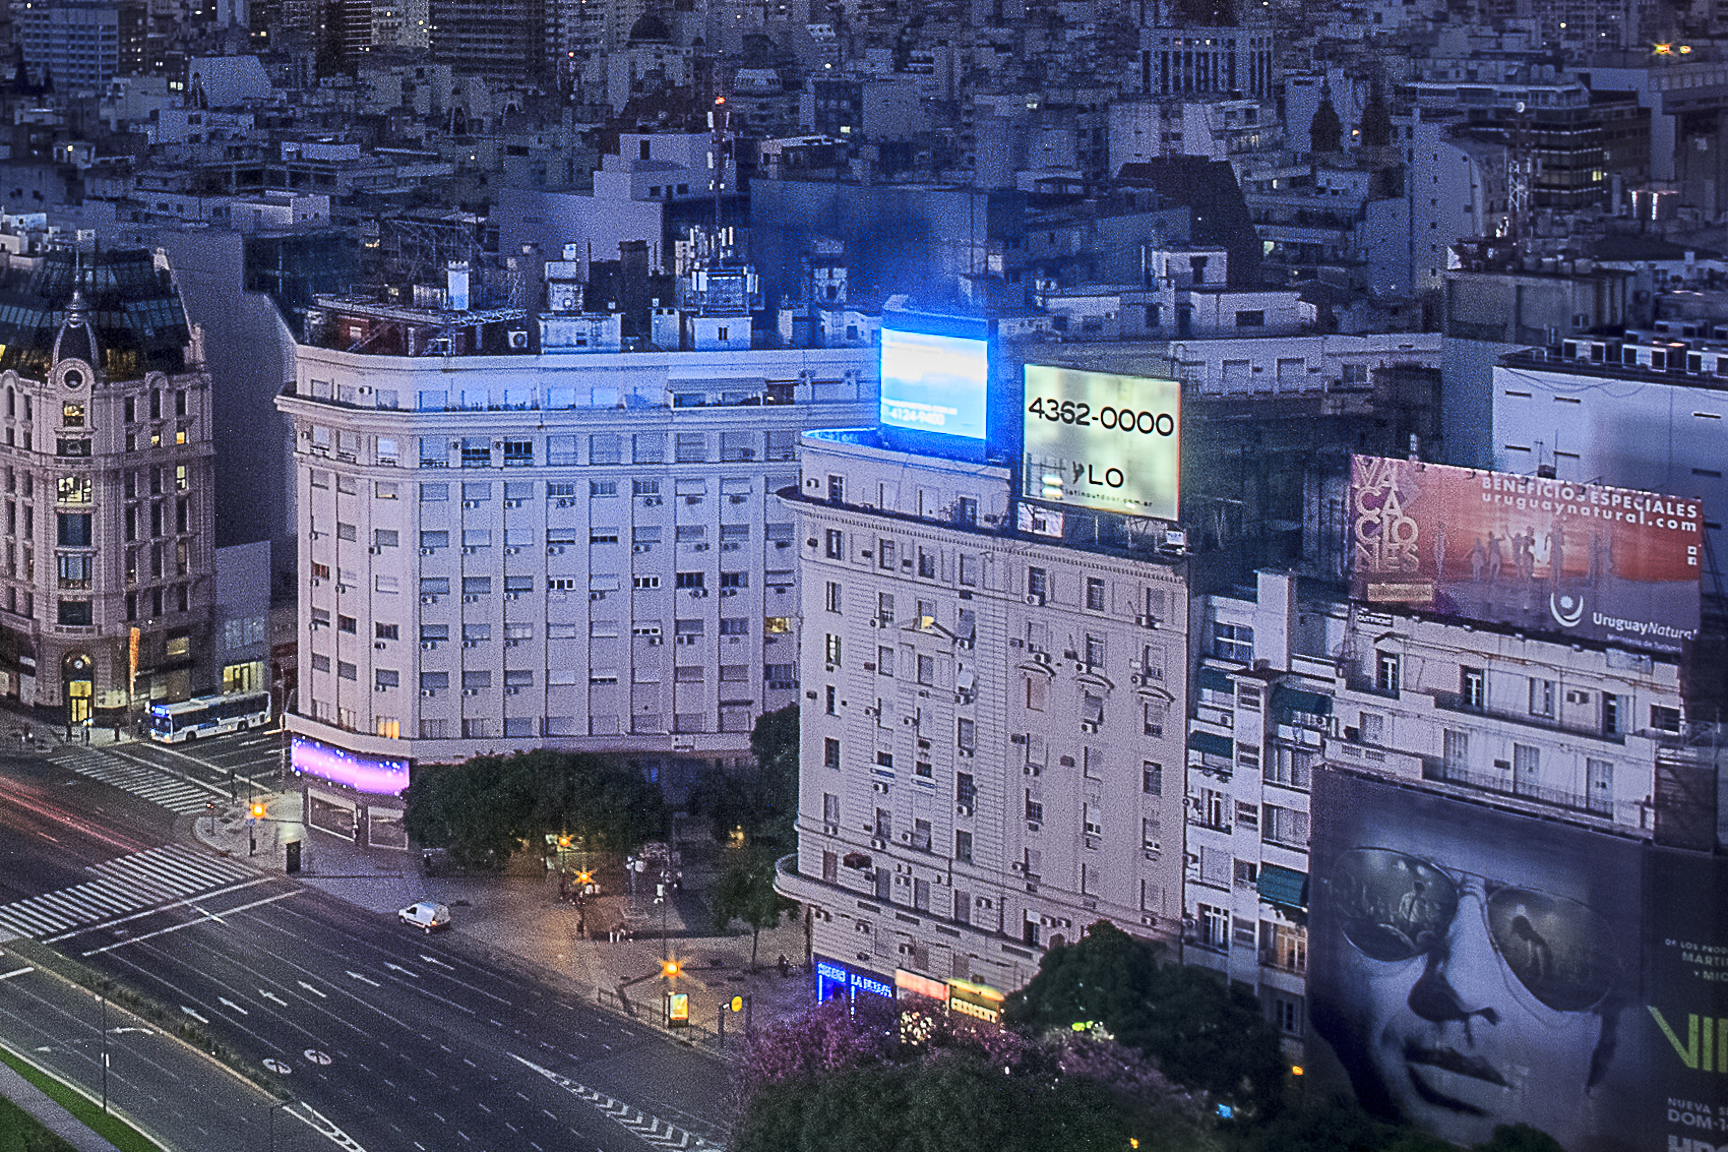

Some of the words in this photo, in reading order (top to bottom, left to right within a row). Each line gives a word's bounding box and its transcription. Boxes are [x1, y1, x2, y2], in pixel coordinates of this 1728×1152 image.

[1028, 397, 1174, 436] 4362-0000
[1482, 492, 1697, 532] uruguaynatural.com
[1590, 490, 1698, 519] ESPECIALES
[1682, 951, 1728, 967] MARTI
[1667, 1097, 1712, 1115] NUEVA
